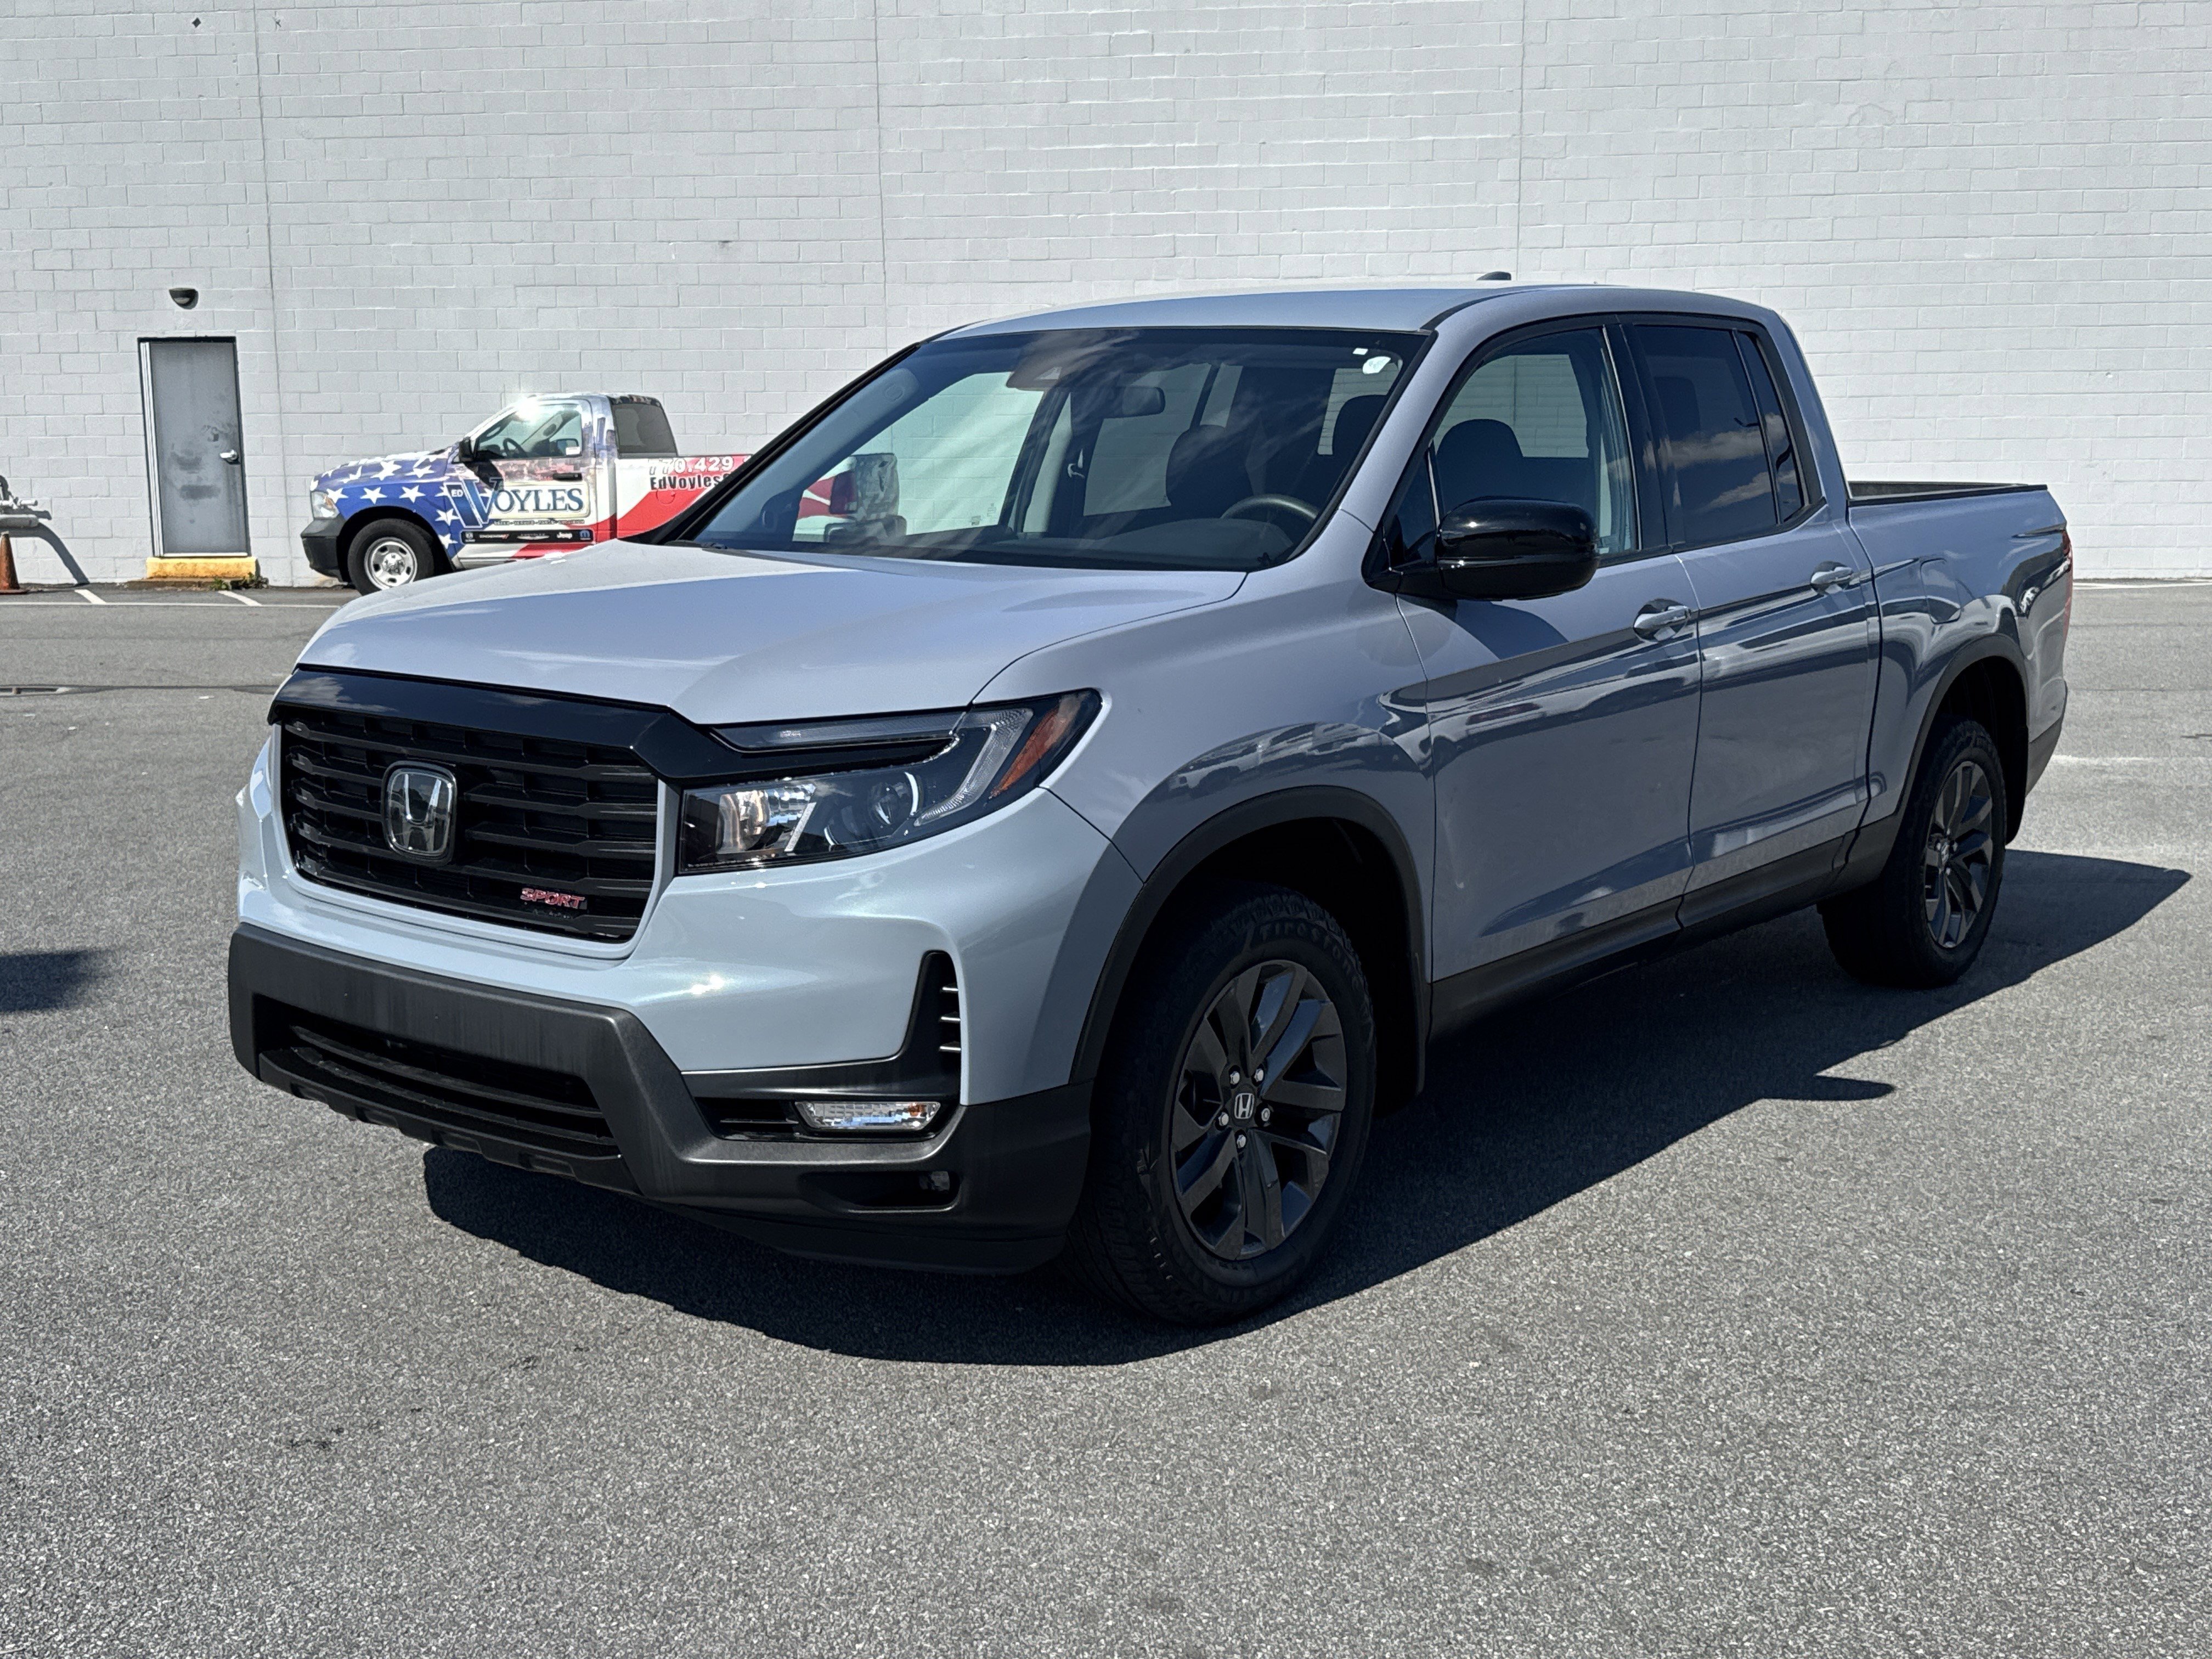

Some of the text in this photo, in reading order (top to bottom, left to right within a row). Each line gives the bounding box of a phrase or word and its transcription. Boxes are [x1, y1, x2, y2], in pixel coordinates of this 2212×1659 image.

[444, 477, 584, 528] ED VOYLES
[520, 888, 585, 909] SPORT
